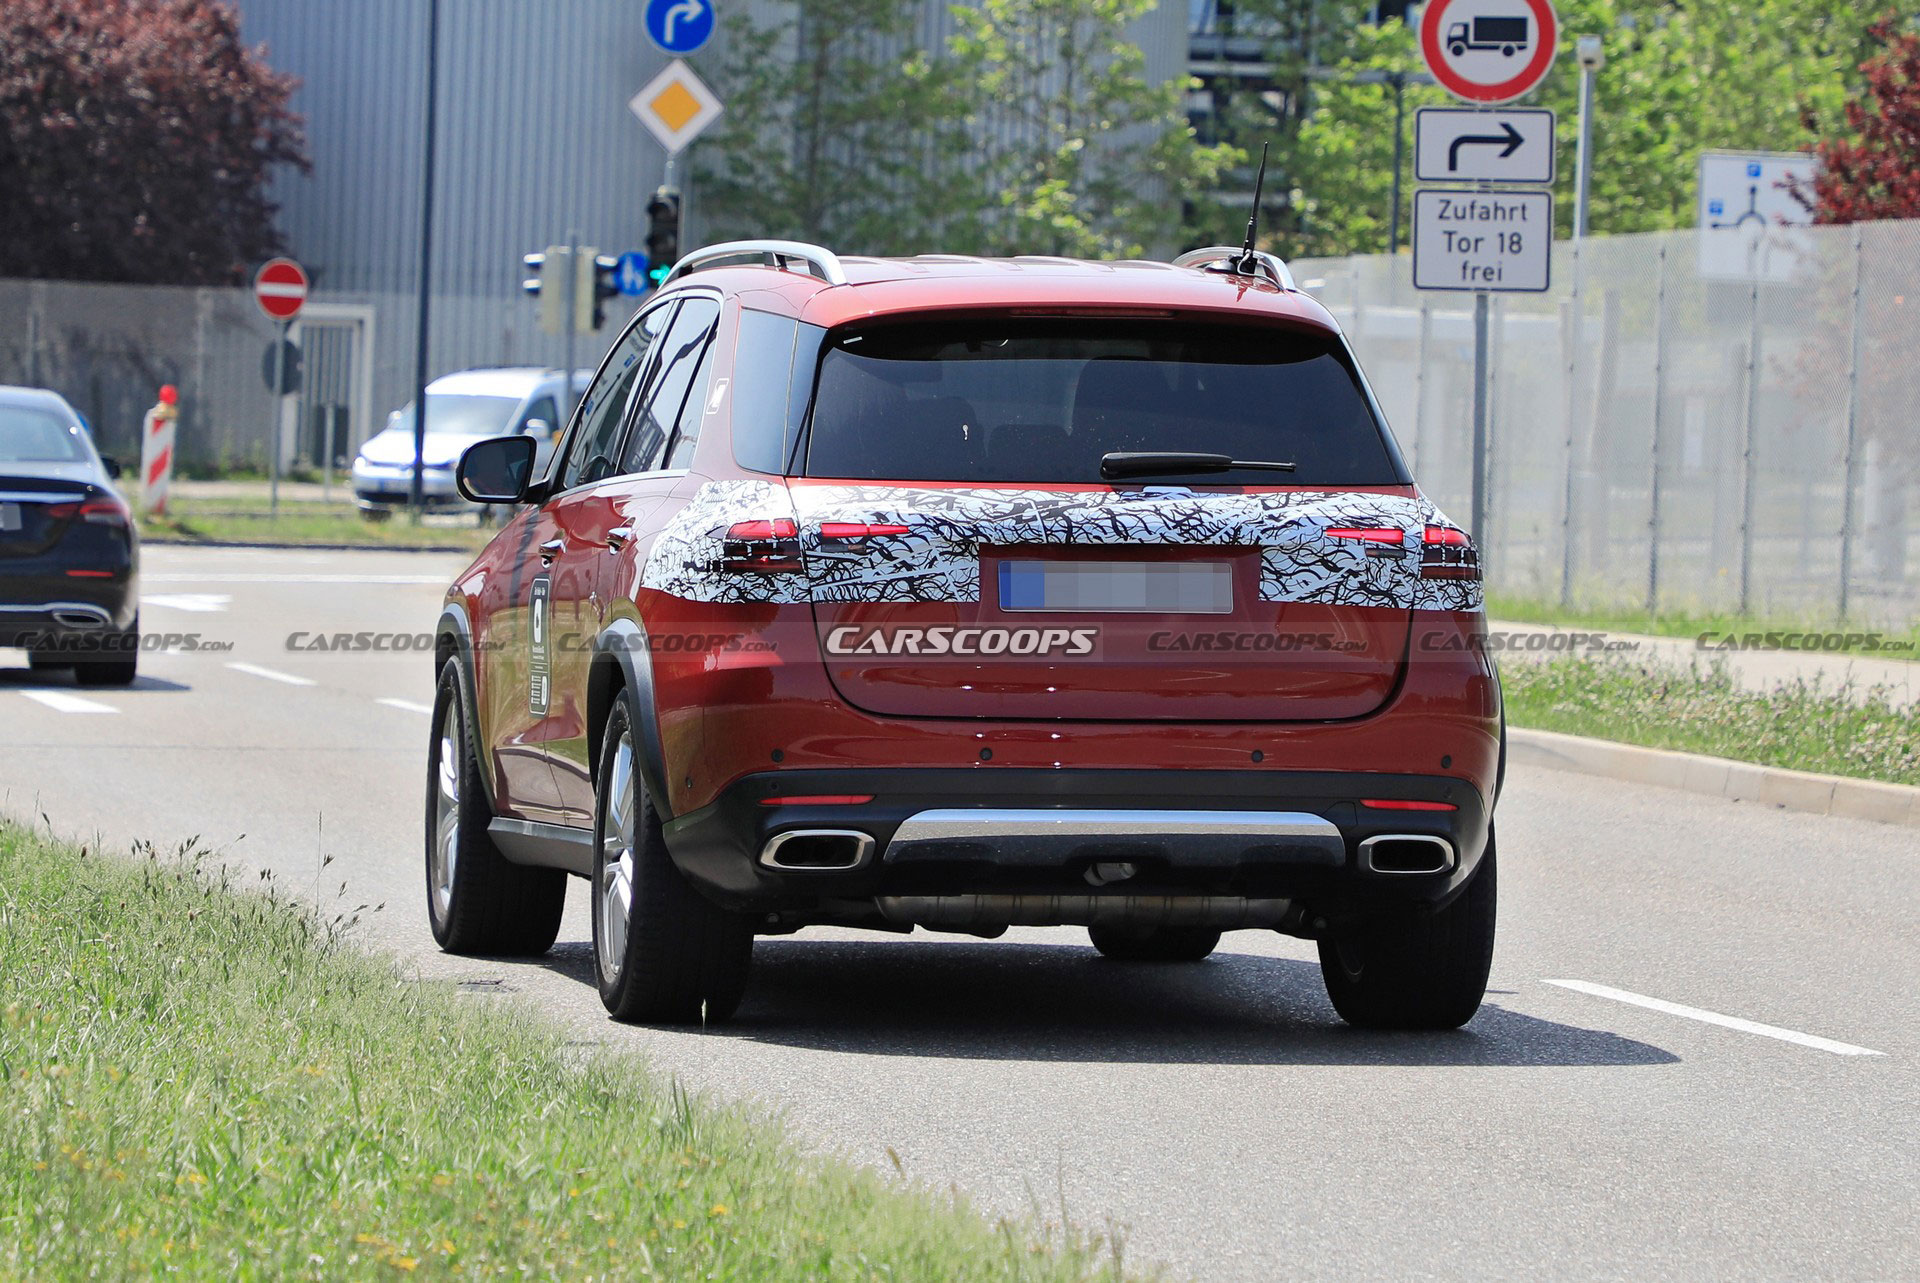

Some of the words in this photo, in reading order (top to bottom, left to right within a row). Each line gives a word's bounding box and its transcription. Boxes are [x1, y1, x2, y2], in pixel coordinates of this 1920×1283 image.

[1438, 200, 1527, 221] Zufahrt
[1443, 231, 1484, 253] Tor
[1499, 233, 1522, 254] 18
[1462, 261, 1502, 281] frei
